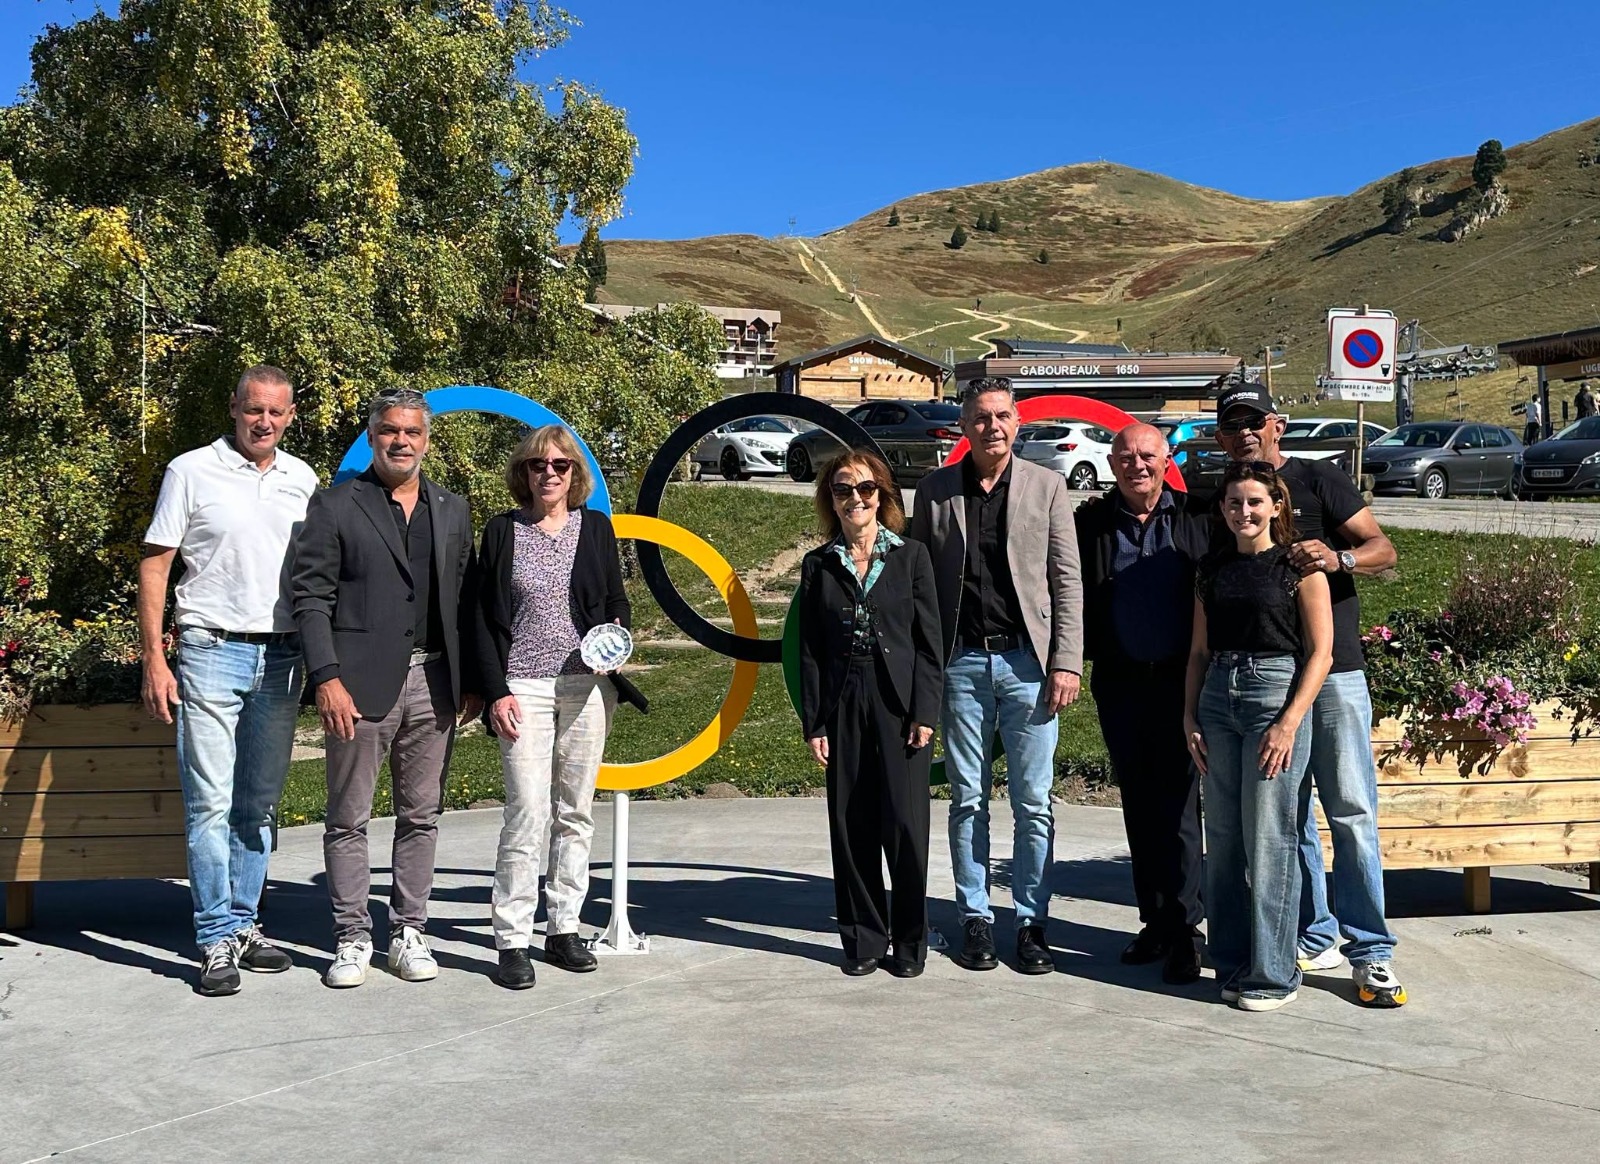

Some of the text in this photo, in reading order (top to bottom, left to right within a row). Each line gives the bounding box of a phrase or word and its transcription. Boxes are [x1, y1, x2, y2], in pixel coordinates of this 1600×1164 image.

[848, 356, 873, 365] SNOW
[1020, 364, 1140, 376] GABOUREAUX 1650
